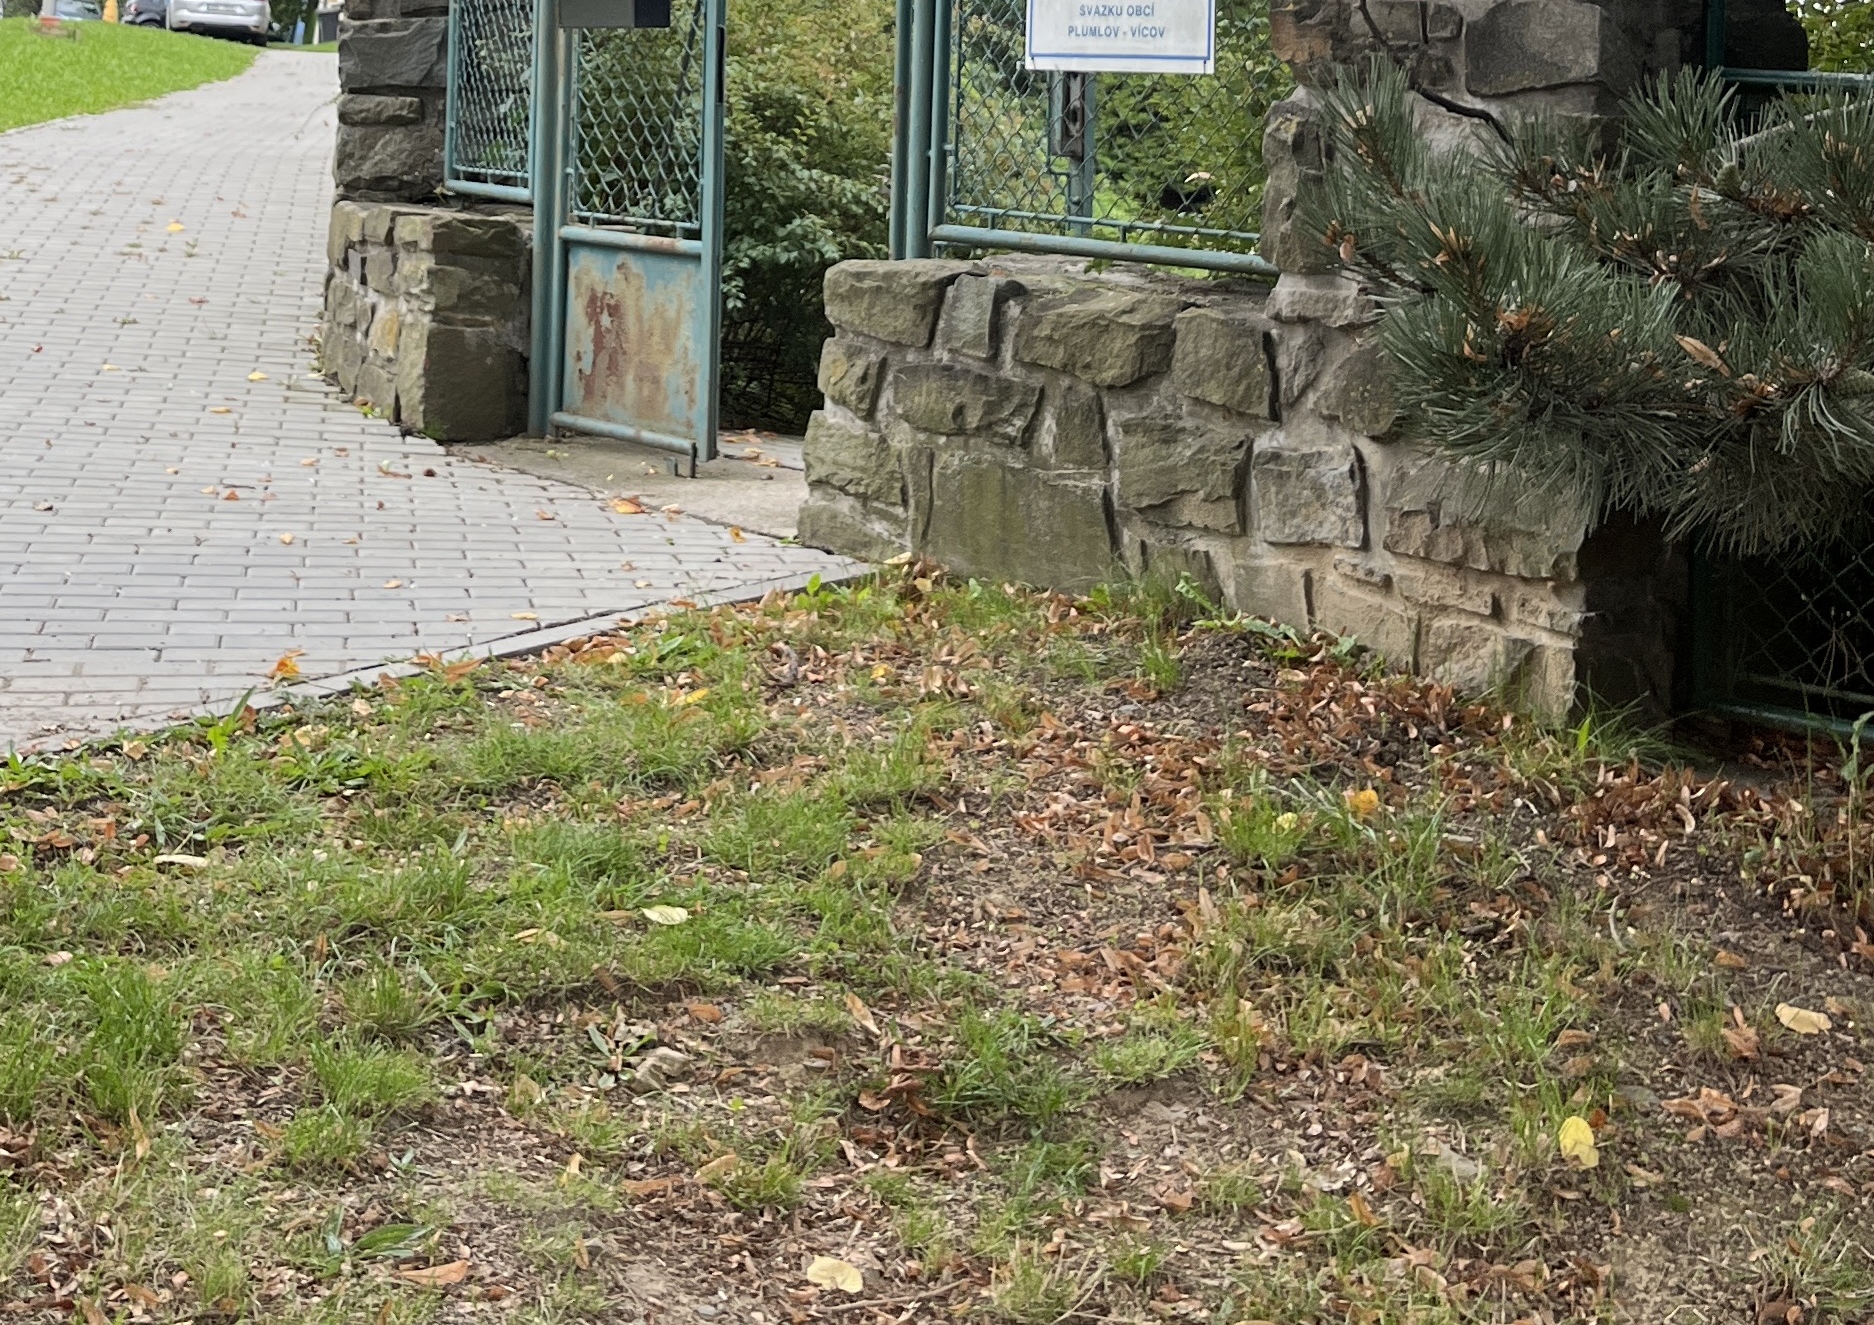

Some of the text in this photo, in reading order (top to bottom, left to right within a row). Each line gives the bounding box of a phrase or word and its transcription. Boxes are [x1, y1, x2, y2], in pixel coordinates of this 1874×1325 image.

[1079, 2, 1155, 17] SVAZKU OBCÍ
[1068, 26, 1119, 38] PLUMLOV
[1131, 23, 1165, 38] VÍCOV
